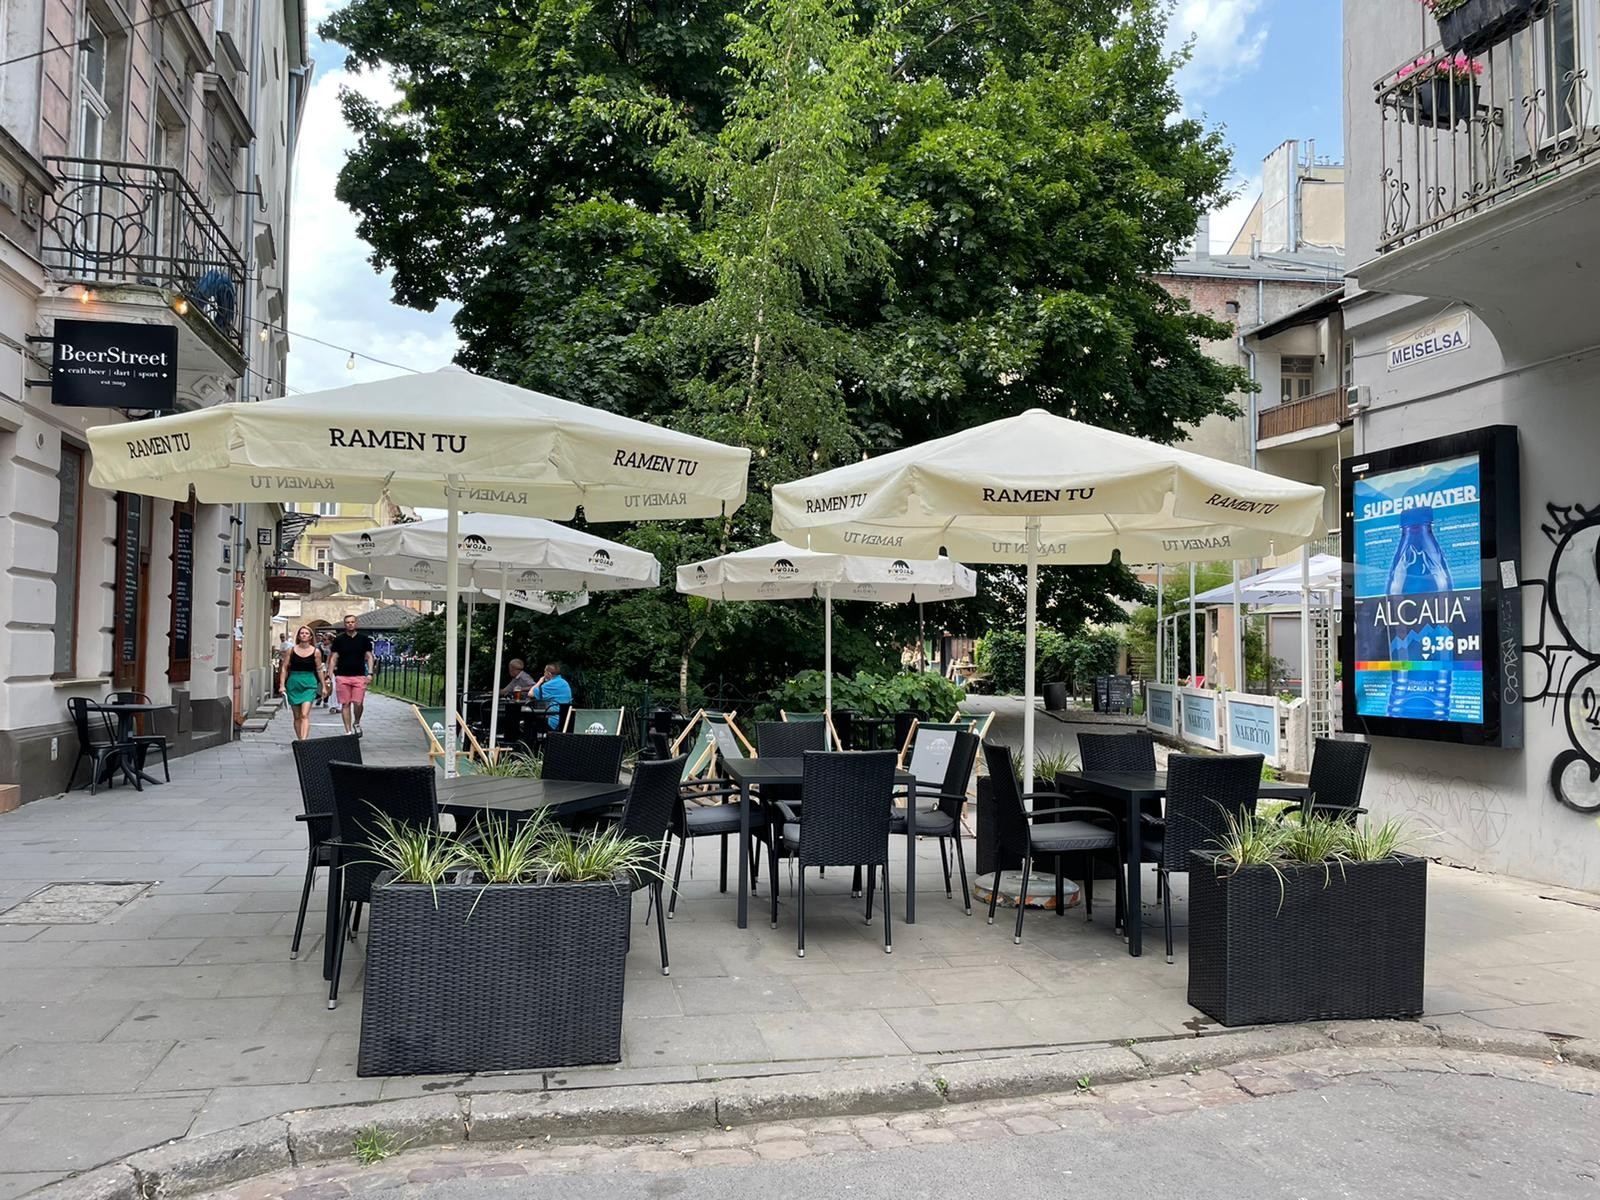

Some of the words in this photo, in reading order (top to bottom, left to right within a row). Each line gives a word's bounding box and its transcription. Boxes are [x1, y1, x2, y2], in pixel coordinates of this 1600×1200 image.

[60, 344, 168, 366] BeerStreet
[1392, 330, 1463, 365] MEISELSA
[88, 367, 106, 375] beer
[138, 371, 158, 379] sport
[127, 435, 171, 458] RAMEN
[169, 433, 190, 450] TU
[329, 428, 425, 450] RAMEN
[432, 434, 467, 453] TU
[613, 450, 674, 473] RAMEN
[677, 459, 698, 476] TU
[806, 495, 849, 514] RAMEN
[850, 493, 867, 508] TU
[982, 488, 1061, 503] RAMEN
[1066, 487, 1095, 500] TU
[1205, 493, 1261, 512] RAMEN
[1256, 503, 1279, 515] TU
[1363, 485, 1477, 518] SUPERWATER
[1374, 597, 1466, 627] ALCALIA
[1422, 635, 1454, 654] 9,36
[1457, 635, 1480, 654] pH
[1234, 723, 1270, 746] NAKRYTO
